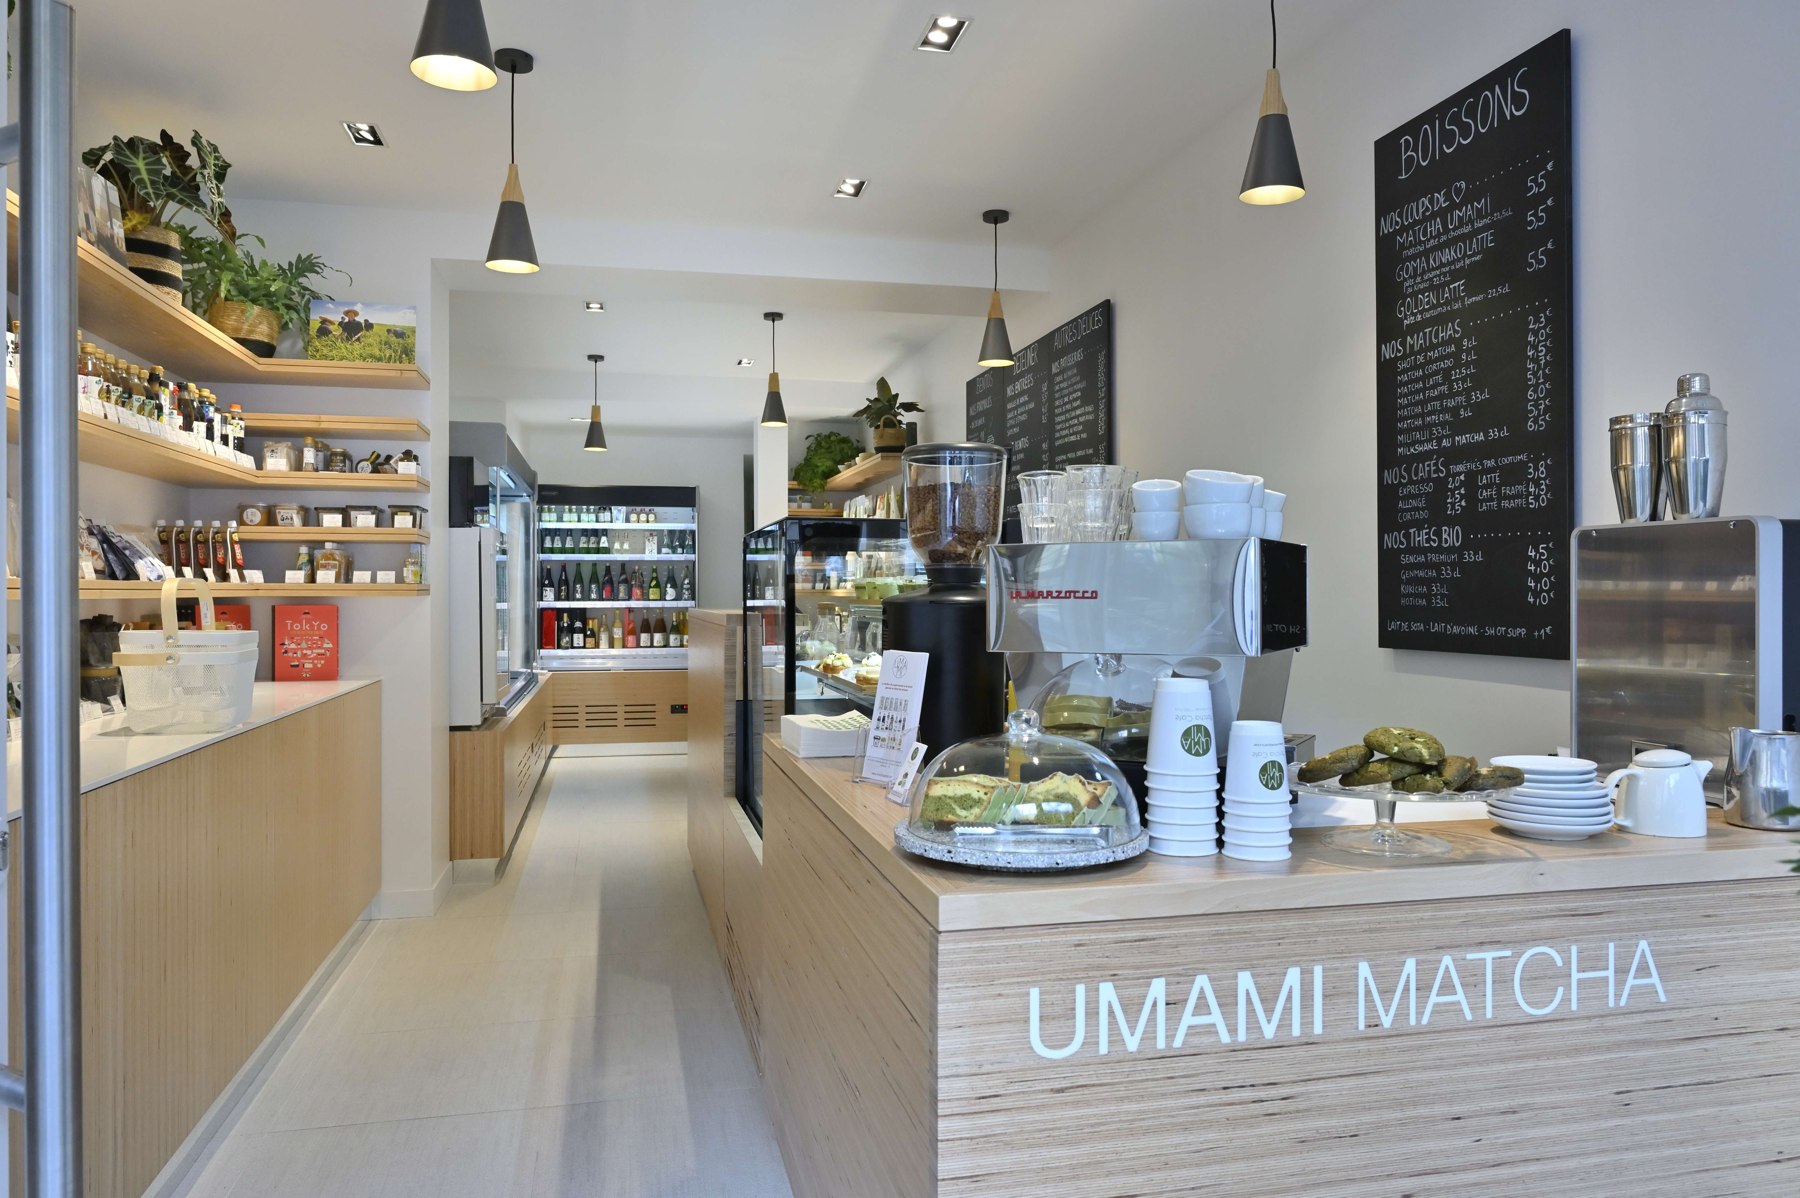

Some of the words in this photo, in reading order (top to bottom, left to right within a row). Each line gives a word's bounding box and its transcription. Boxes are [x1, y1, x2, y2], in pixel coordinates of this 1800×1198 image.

[1380, 209, 1400, 236] NOS
[1403, 194, 1431, 225] COUPS
[1434, 189, 1449, 211] DE
[1396, 217, 1443, 250] MATCHA
[1448, 193, 1491, 229] UMAMI
[1402, 243, 1424, 258] matcha
[1448, 224, 1473, 238] chocolat
[1395, 257, 1427, 282] GOMA
[1430, 242, 1464, 268] KINAKO
[1467, 230, 1495, 253] LATTE
[1397, 291, 1437, 319] GOLDEN
[1440, 279, 1466, 301] LATTE
[1381, 339, 1403, 362] NOS
[1407, 319, 1461, 354] MATCHAS
[1397, 357, 1415, 372] SHOT
[1417, 354, 1425, 365] DE
[1427, 344, 1455, 361] MATCHA
[1398, 369, 1422, 384] MATCHA
[1425, 358, 1454, 373] CORTADO
[1398, 382, 1423, 396] MATCHA
[1398, 393, 1424, 408] MATCHA
[1398, 406, 1422, 419] MATCHA
[1398, 418, 1422, 430] MATCHA
[1398, 440, 1438, 457] MILKSHAKE
[1441, 436, 1452, 448] AU
[1455, 432, 1485, 446] MATCHA
[1384, 464, 1408, 485] NOS
[1411, 455, 1446, 481] CAFÉS
[1483, 458, 1497, 468] PAR
[1398, 496, 1426, 509] ALLONGÉ
[1478, 485, 1497, 499] CAFÉ
[1398, 510, 1429, 522] CORTADO
[1384, 531, 1407, 549] NOS
[1409, 524, 1438, 547] THÉS
[1442, 525, 1462, 548] BIO
[1400, 554, 1425, 564] SENCHA
[1428, 553, 1458, 563] PREMIUM
[1026, 590, 1098, 600] MARZOCCO
[1400, 584, 1427, 594] KUKICHA
[1388, 619, 1400, 631] LAIT
[1401, 622, 1408, 631] DE
[1430, 621, 1445, 632] LAIT
[1029, 964, 1323, 1060] UMAMI
[1358, 939, 1668, 1031] MATCHA
